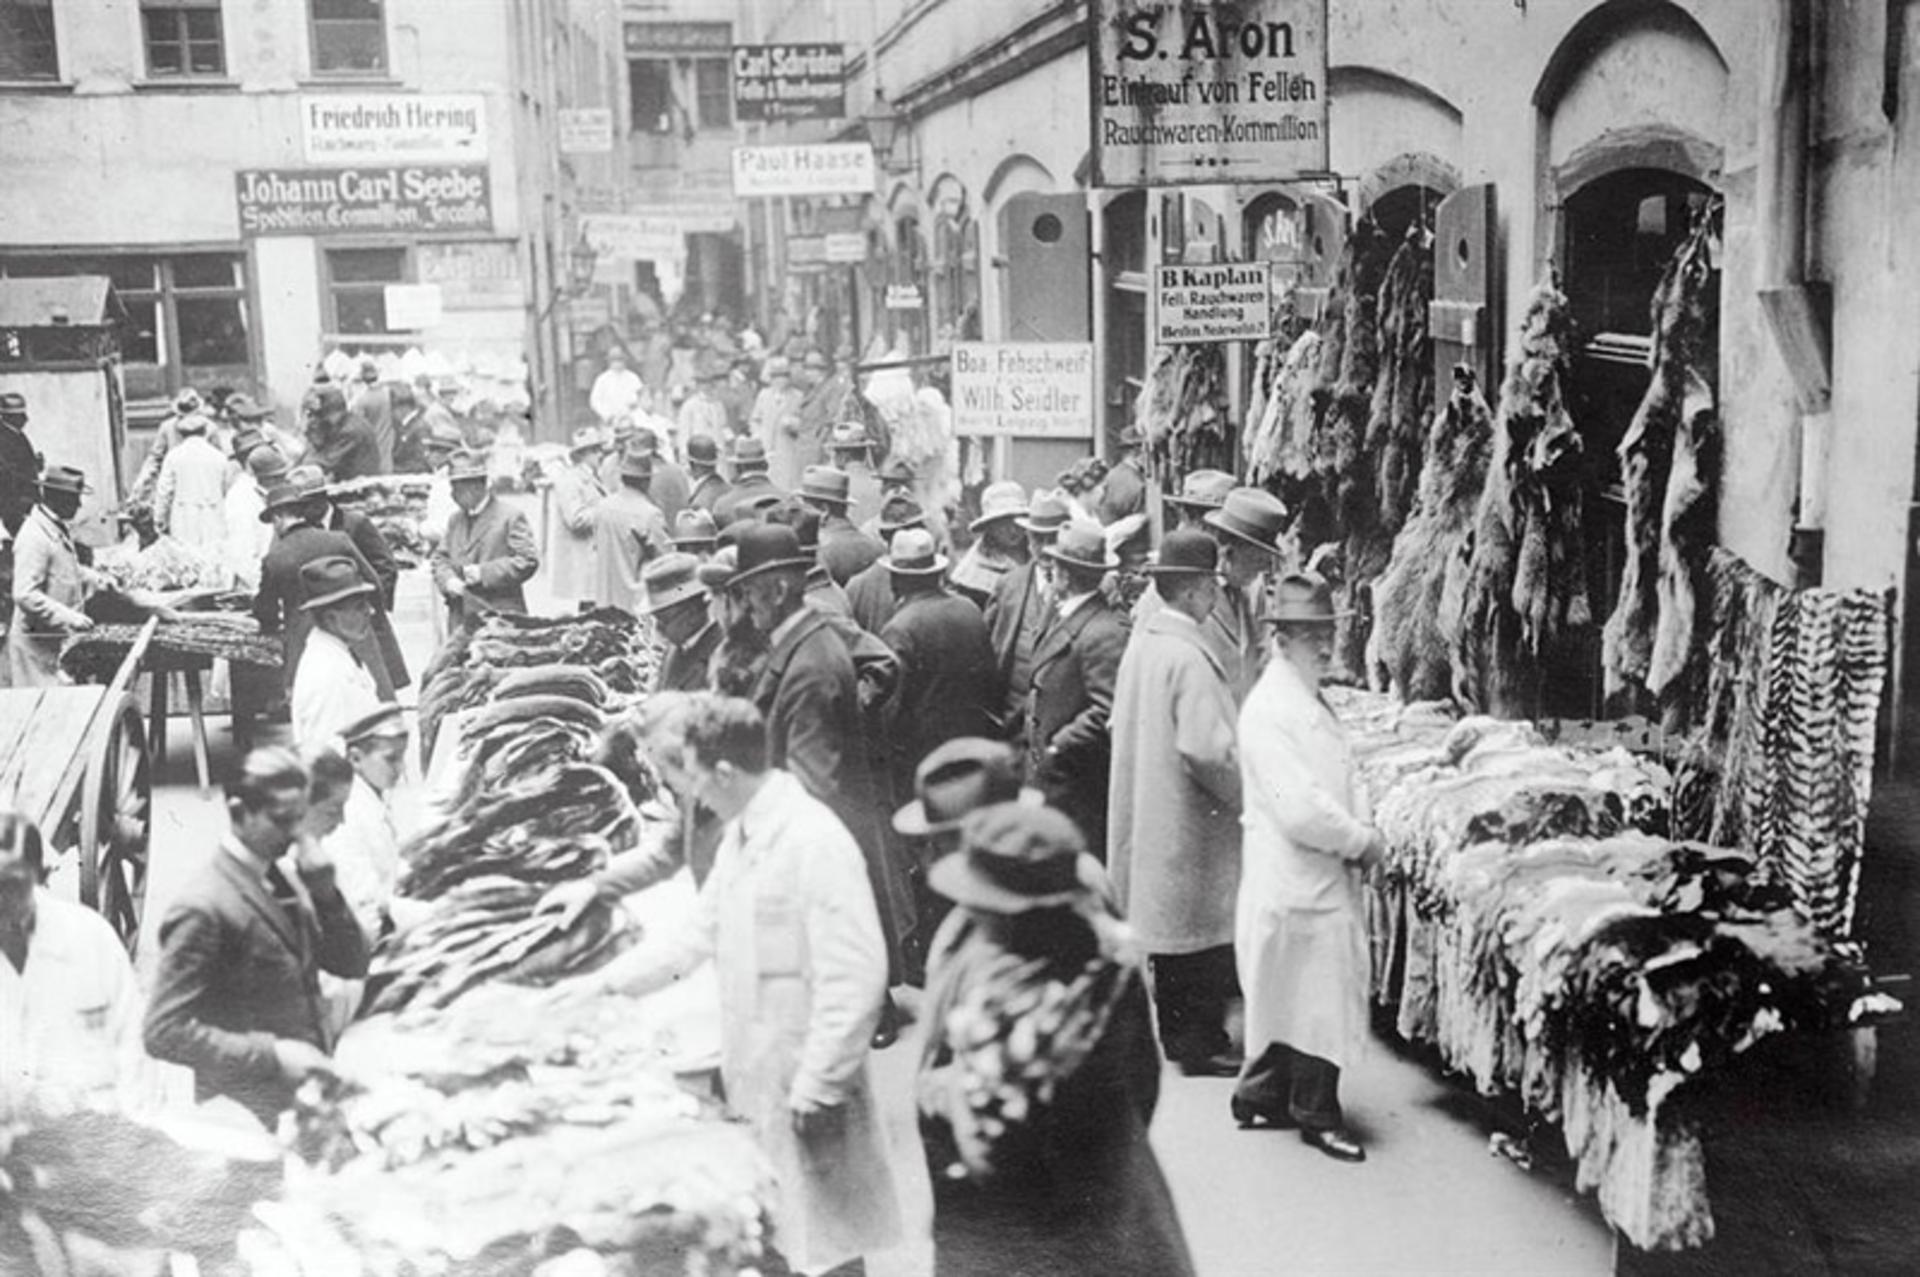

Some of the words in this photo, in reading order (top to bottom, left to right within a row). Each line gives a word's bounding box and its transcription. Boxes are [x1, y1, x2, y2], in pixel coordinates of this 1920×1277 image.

[1116, 9, 1168, 60] S.
[1178, 12, 1295, 59] Aron
[1103, 68, 1193, 106] Einkauf
[1198, 81, 1239, 103] von
[1248, 71, 1316, 103] Fellen
[310, 102, 400, 129] Friedrich
[405, 101, 477, 134] Hering
[740, 150, 786, 171] Paul
[794, 149, 865, 171] Haase
[241, 173, 337, 203] Johann
[338, 171, 399, 201] Carl
[403, 169, 483, 200] Seebe
[1183, 267, 1263, 289] Kaplan
[1011, 385, 1081, 412] Seidler
